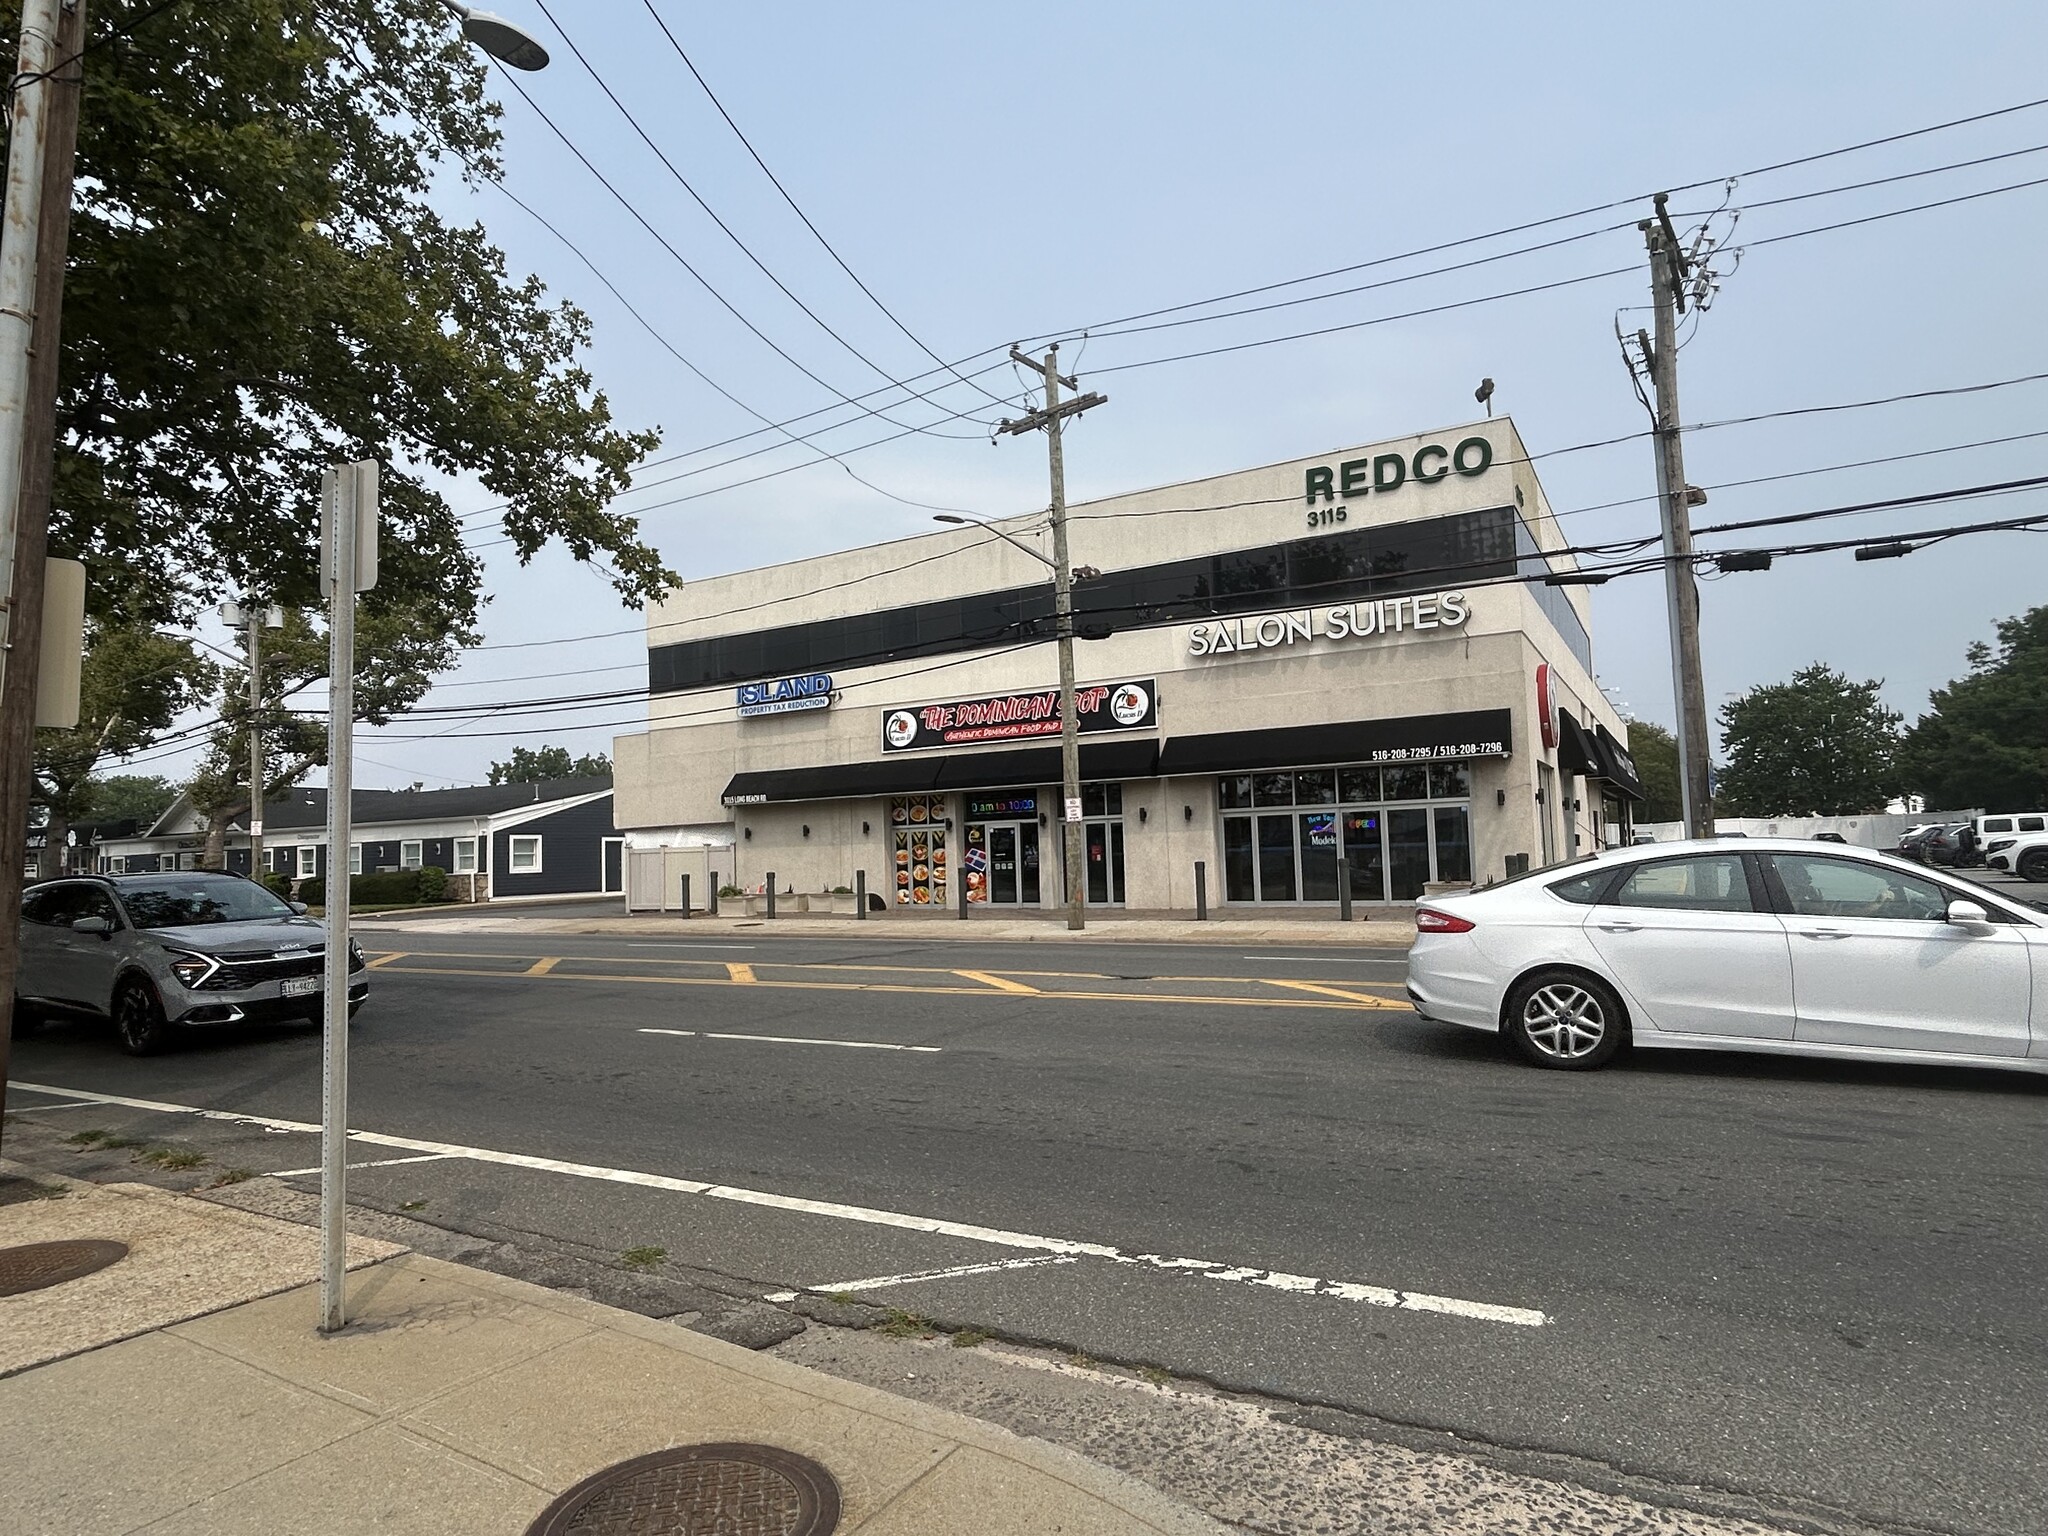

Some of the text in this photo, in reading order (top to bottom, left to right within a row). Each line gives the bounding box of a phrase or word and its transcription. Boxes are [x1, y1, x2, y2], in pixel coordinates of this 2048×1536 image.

[1305, 436, 1492, 505] REDCO
[1307, 506, 1347, 527] 3115
[1188, 591, 1466, 656] SALON SUITES
[737, 673, 831, 705] ISLAND
[741, 698, 826, 715] PROPERTY TAX REDUCTION
[955, 692, 1055, 726] DOMINICAN
[947, 729, 982, 740] AUTHENTIC
[983, 723, 1019, 737] DOMINICAN
[1020, 721, 1042, 733] FOOD
[1042, 719, 1060, 731] AND
[1372, 746, 1431, 760] 516-208-7295
[1439, 741, 1503, 756] 516-208-7296
